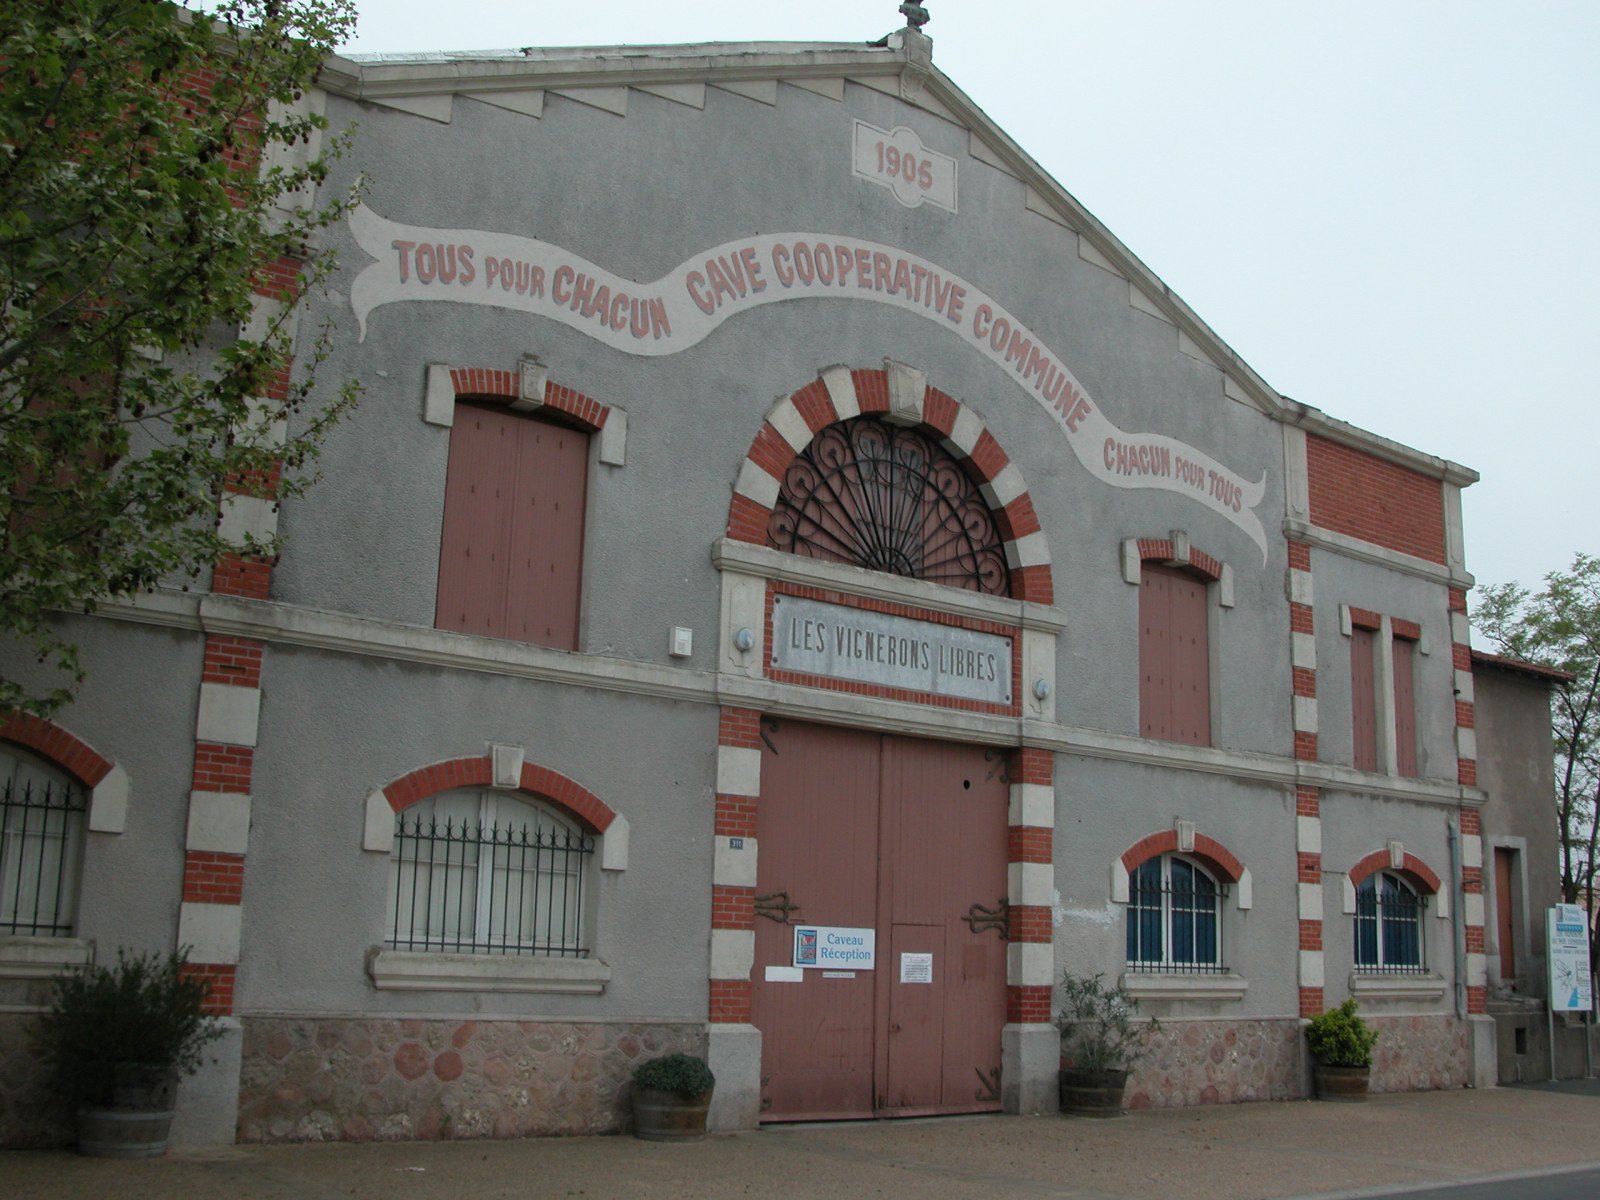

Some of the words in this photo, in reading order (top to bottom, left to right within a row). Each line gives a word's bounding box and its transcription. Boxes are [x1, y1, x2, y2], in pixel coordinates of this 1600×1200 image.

[875, 141, 933, 190] 1905
[391, 239, 476, 286] TOUS
[485, 256, 546, 299] POUR
[552, 265, 672, 340] CHACUN
[686, 247, 767, 315] CAVE
[771, 241, 967, 324] COOPERATIVE
[973, 304, 1092, 435] COMMUNE
[1103, 437, 1171, 478] CHACUN
[1175, 456, 1205, 491] POUR
[1208, 469, 1243, 512] TOUS
[791, 618, 825, 652] LES
[836, 625, 930, 670] VIGNERONS
[939, 645, 995, 682] LIBRES
[820, 947, 871, 962] Réception
[827, 933, 864, 946] Caveau
